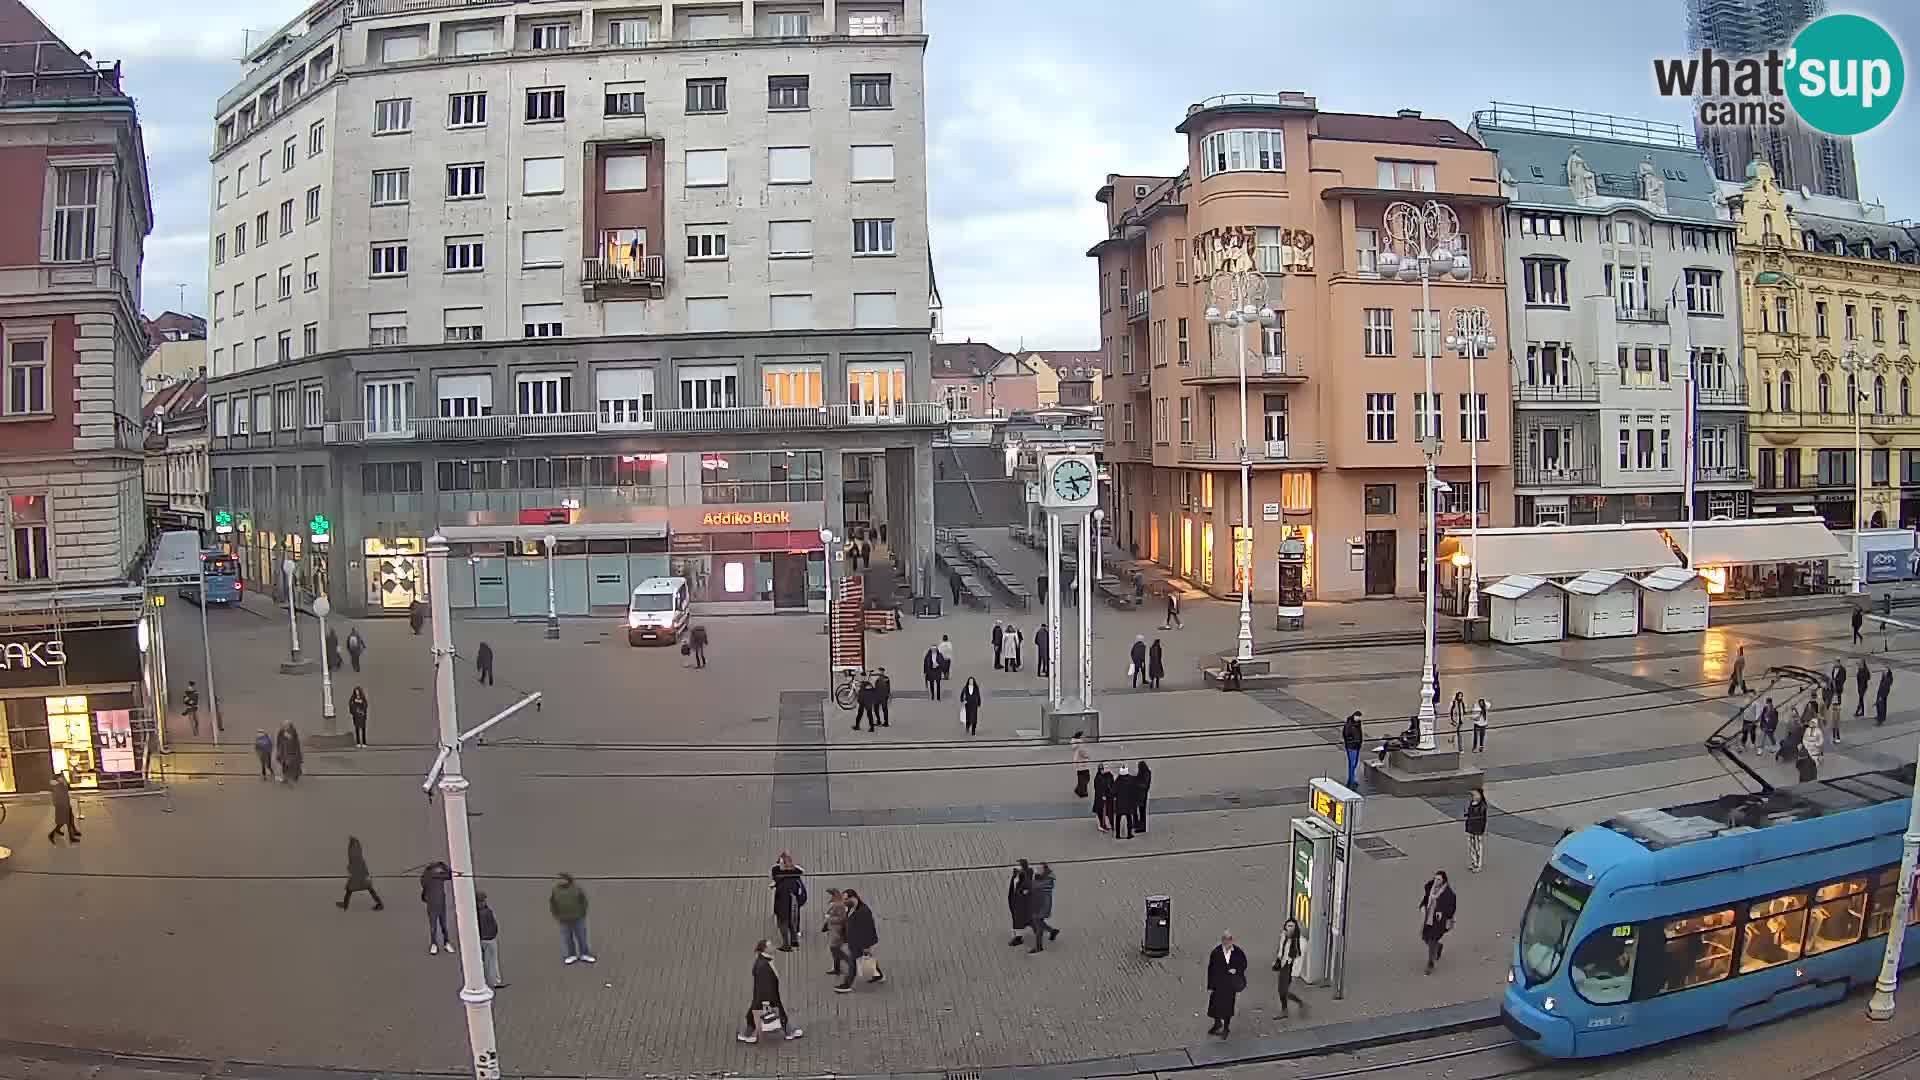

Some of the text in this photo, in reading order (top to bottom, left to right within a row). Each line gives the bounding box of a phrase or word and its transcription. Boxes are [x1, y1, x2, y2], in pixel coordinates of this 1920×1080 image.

[703, 510, 791, 525] Addiko Bank
[0, 640, 67, 669] AKS
